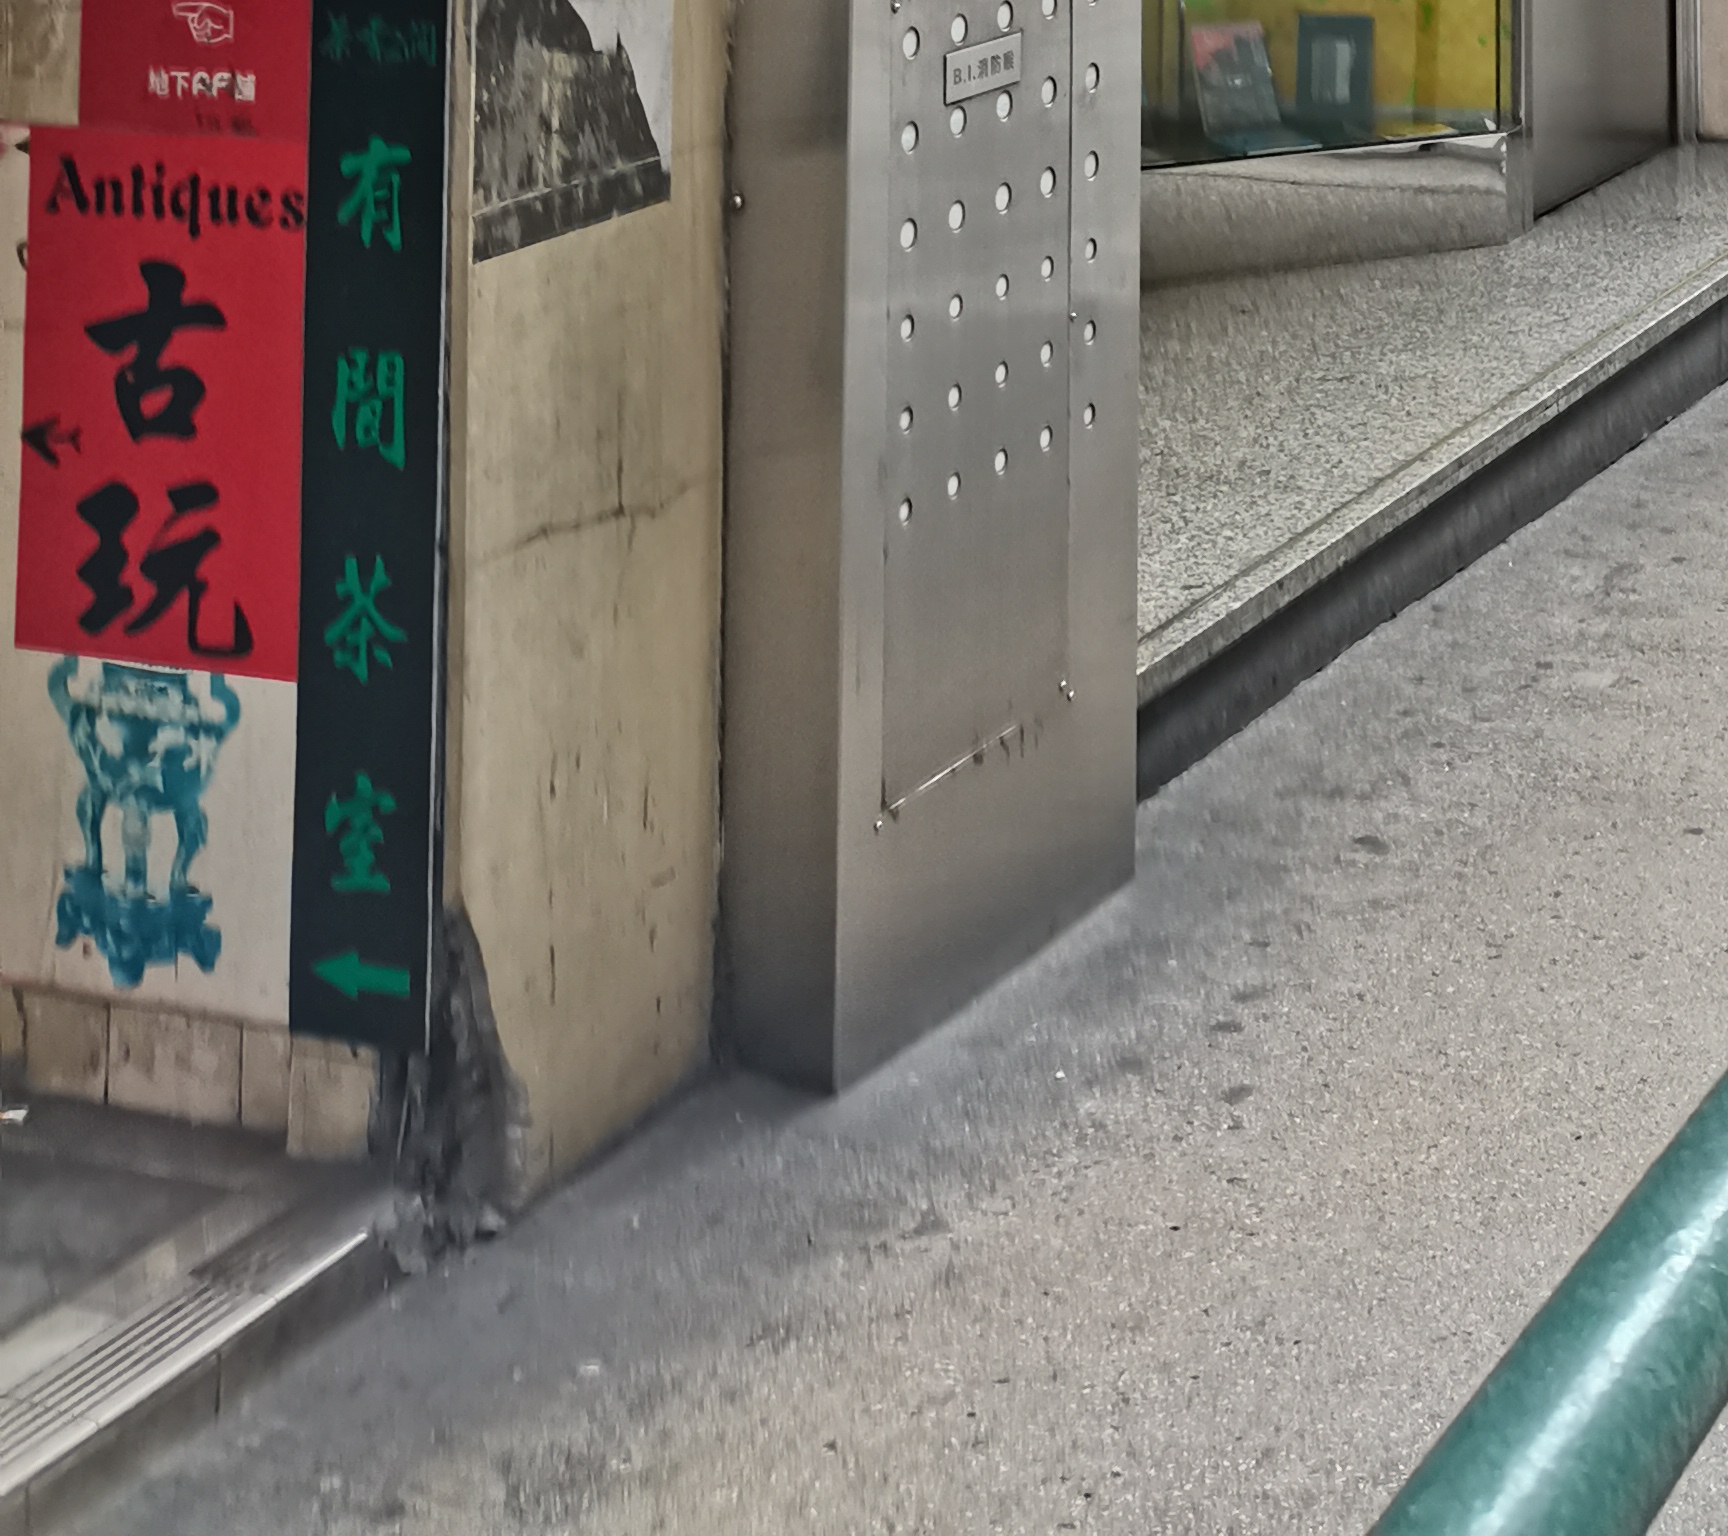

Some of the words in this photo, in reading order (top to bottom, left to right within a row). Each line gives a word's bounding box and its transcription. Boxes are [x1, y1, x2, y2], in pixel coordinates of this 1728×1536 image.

[45, 153, 306, 240] Antiques
[76, 259, 253, 658] 古玩
[325, 134, 413, 894] 有間茶室
